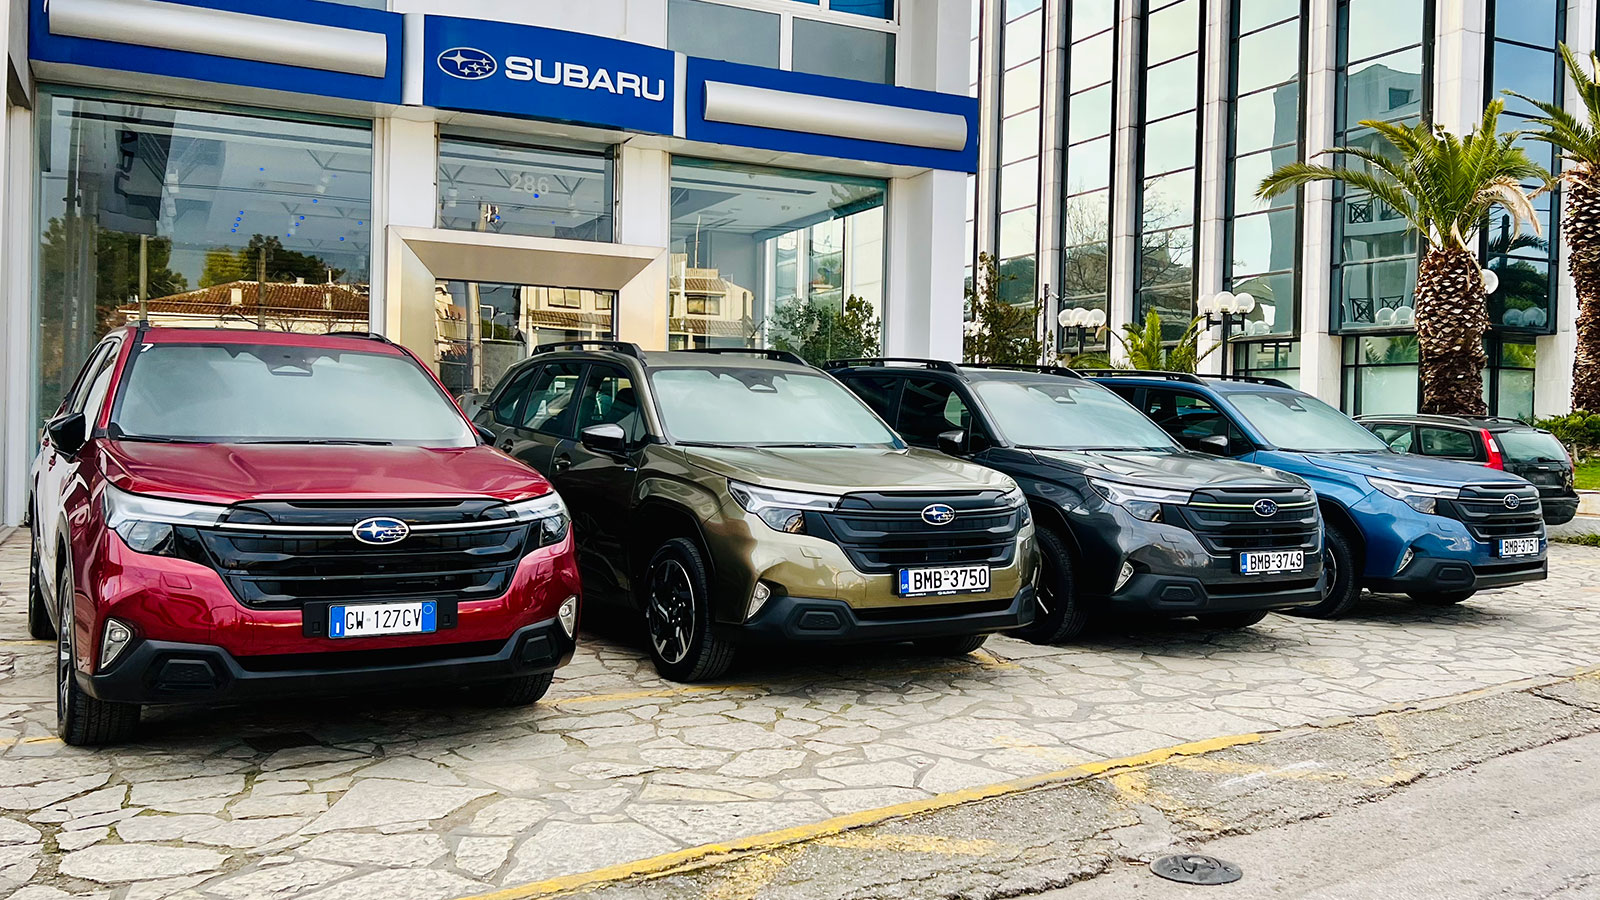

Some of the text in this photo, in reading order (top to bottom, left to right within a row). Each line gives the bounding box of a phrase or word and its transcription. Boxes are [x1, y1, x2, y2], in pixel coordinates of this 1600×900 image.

[504, 55, 665, 101] SUBARU
[510, 173, 549, 195] 286
[1504, 539, 1538, 553] BMB-3751
[1250, 552, 1302, 570] BMB-3749
[914, 568, 987, 590] BMB-3750
[345, 609, 421, 630] GW 127GV
